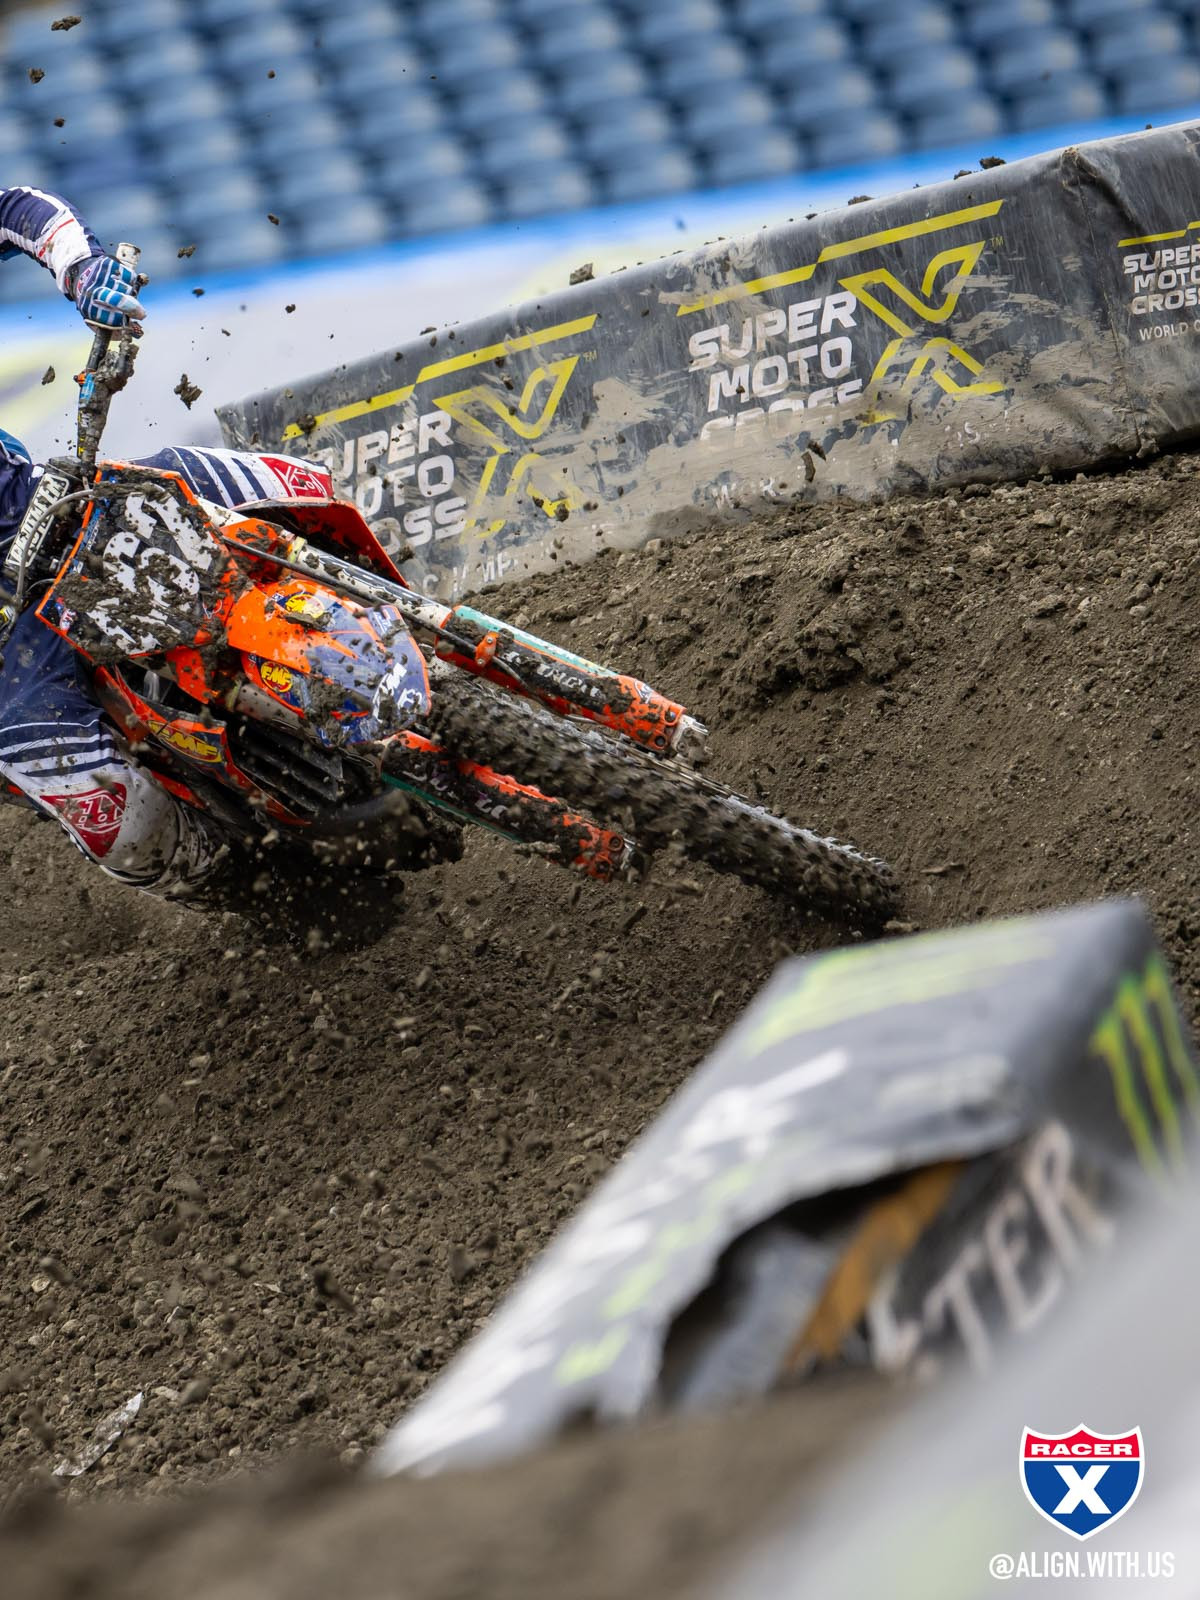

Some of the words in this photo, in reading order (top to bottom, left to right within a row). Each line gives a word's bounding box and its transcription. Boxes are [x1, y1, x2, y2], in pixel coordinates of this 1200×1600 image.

[688, 289, 857, 373] SUPER
[1131, 287, 1200, 315] CROS
[1139, 321, 1189, 341] WORLD
[706, 336, 853, 413] MOTO
[341, 454, 455, 518] OTO
